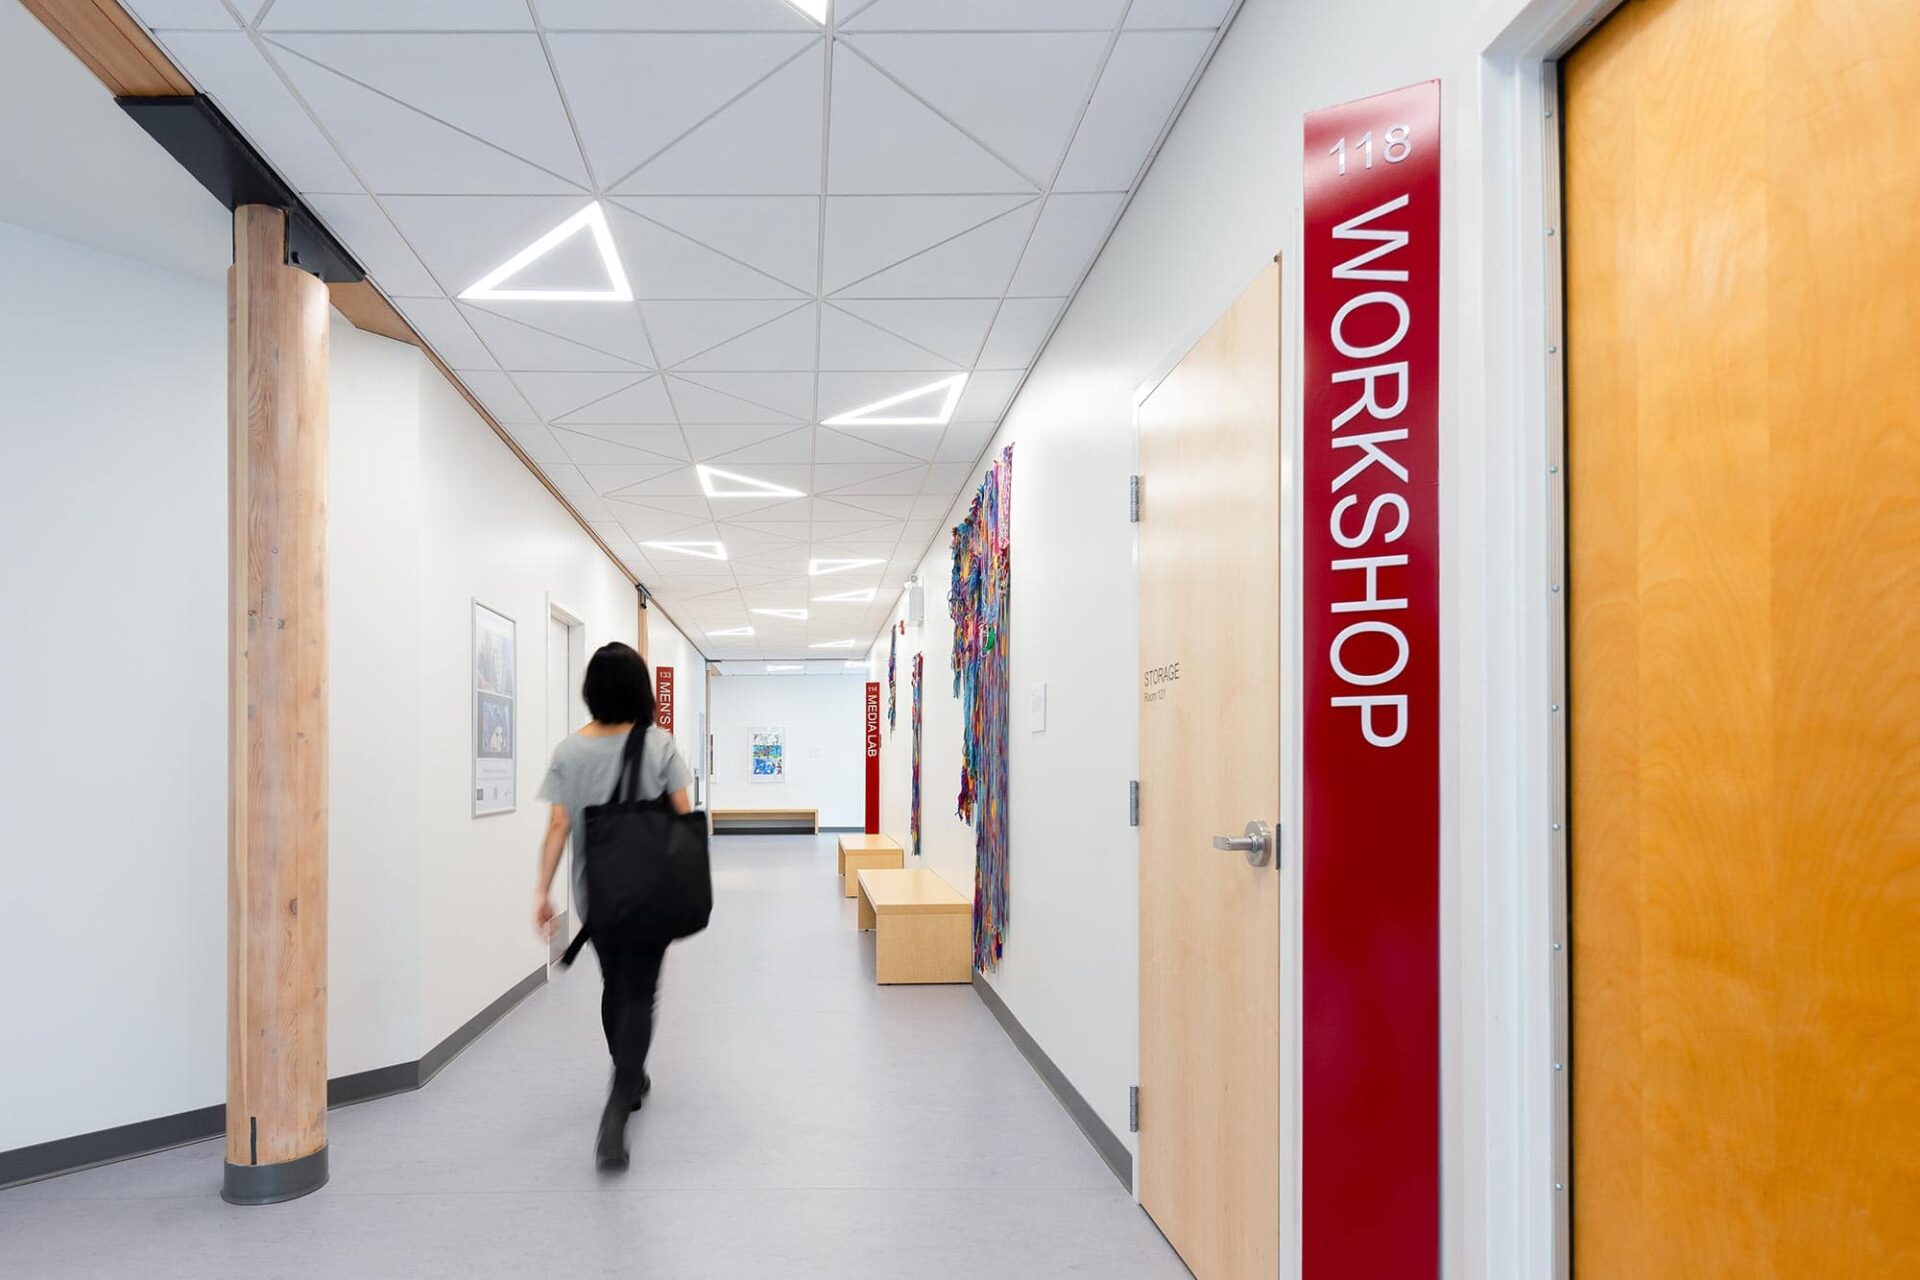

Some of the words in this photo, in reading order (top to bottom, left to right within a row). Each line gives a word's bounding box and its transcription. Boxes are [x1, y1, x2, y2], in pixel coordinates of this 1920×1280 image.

[1329, 123, 1412, 176] 118
[1331, 194, 1410, 747] WORKSHOP
[1144, 662, 1180, 687] STORAGE
[660, 682, 671, 725] MEN'S
[868, 695, 877, 733] MEDIA
[868, 735, 877, 757] LAB
